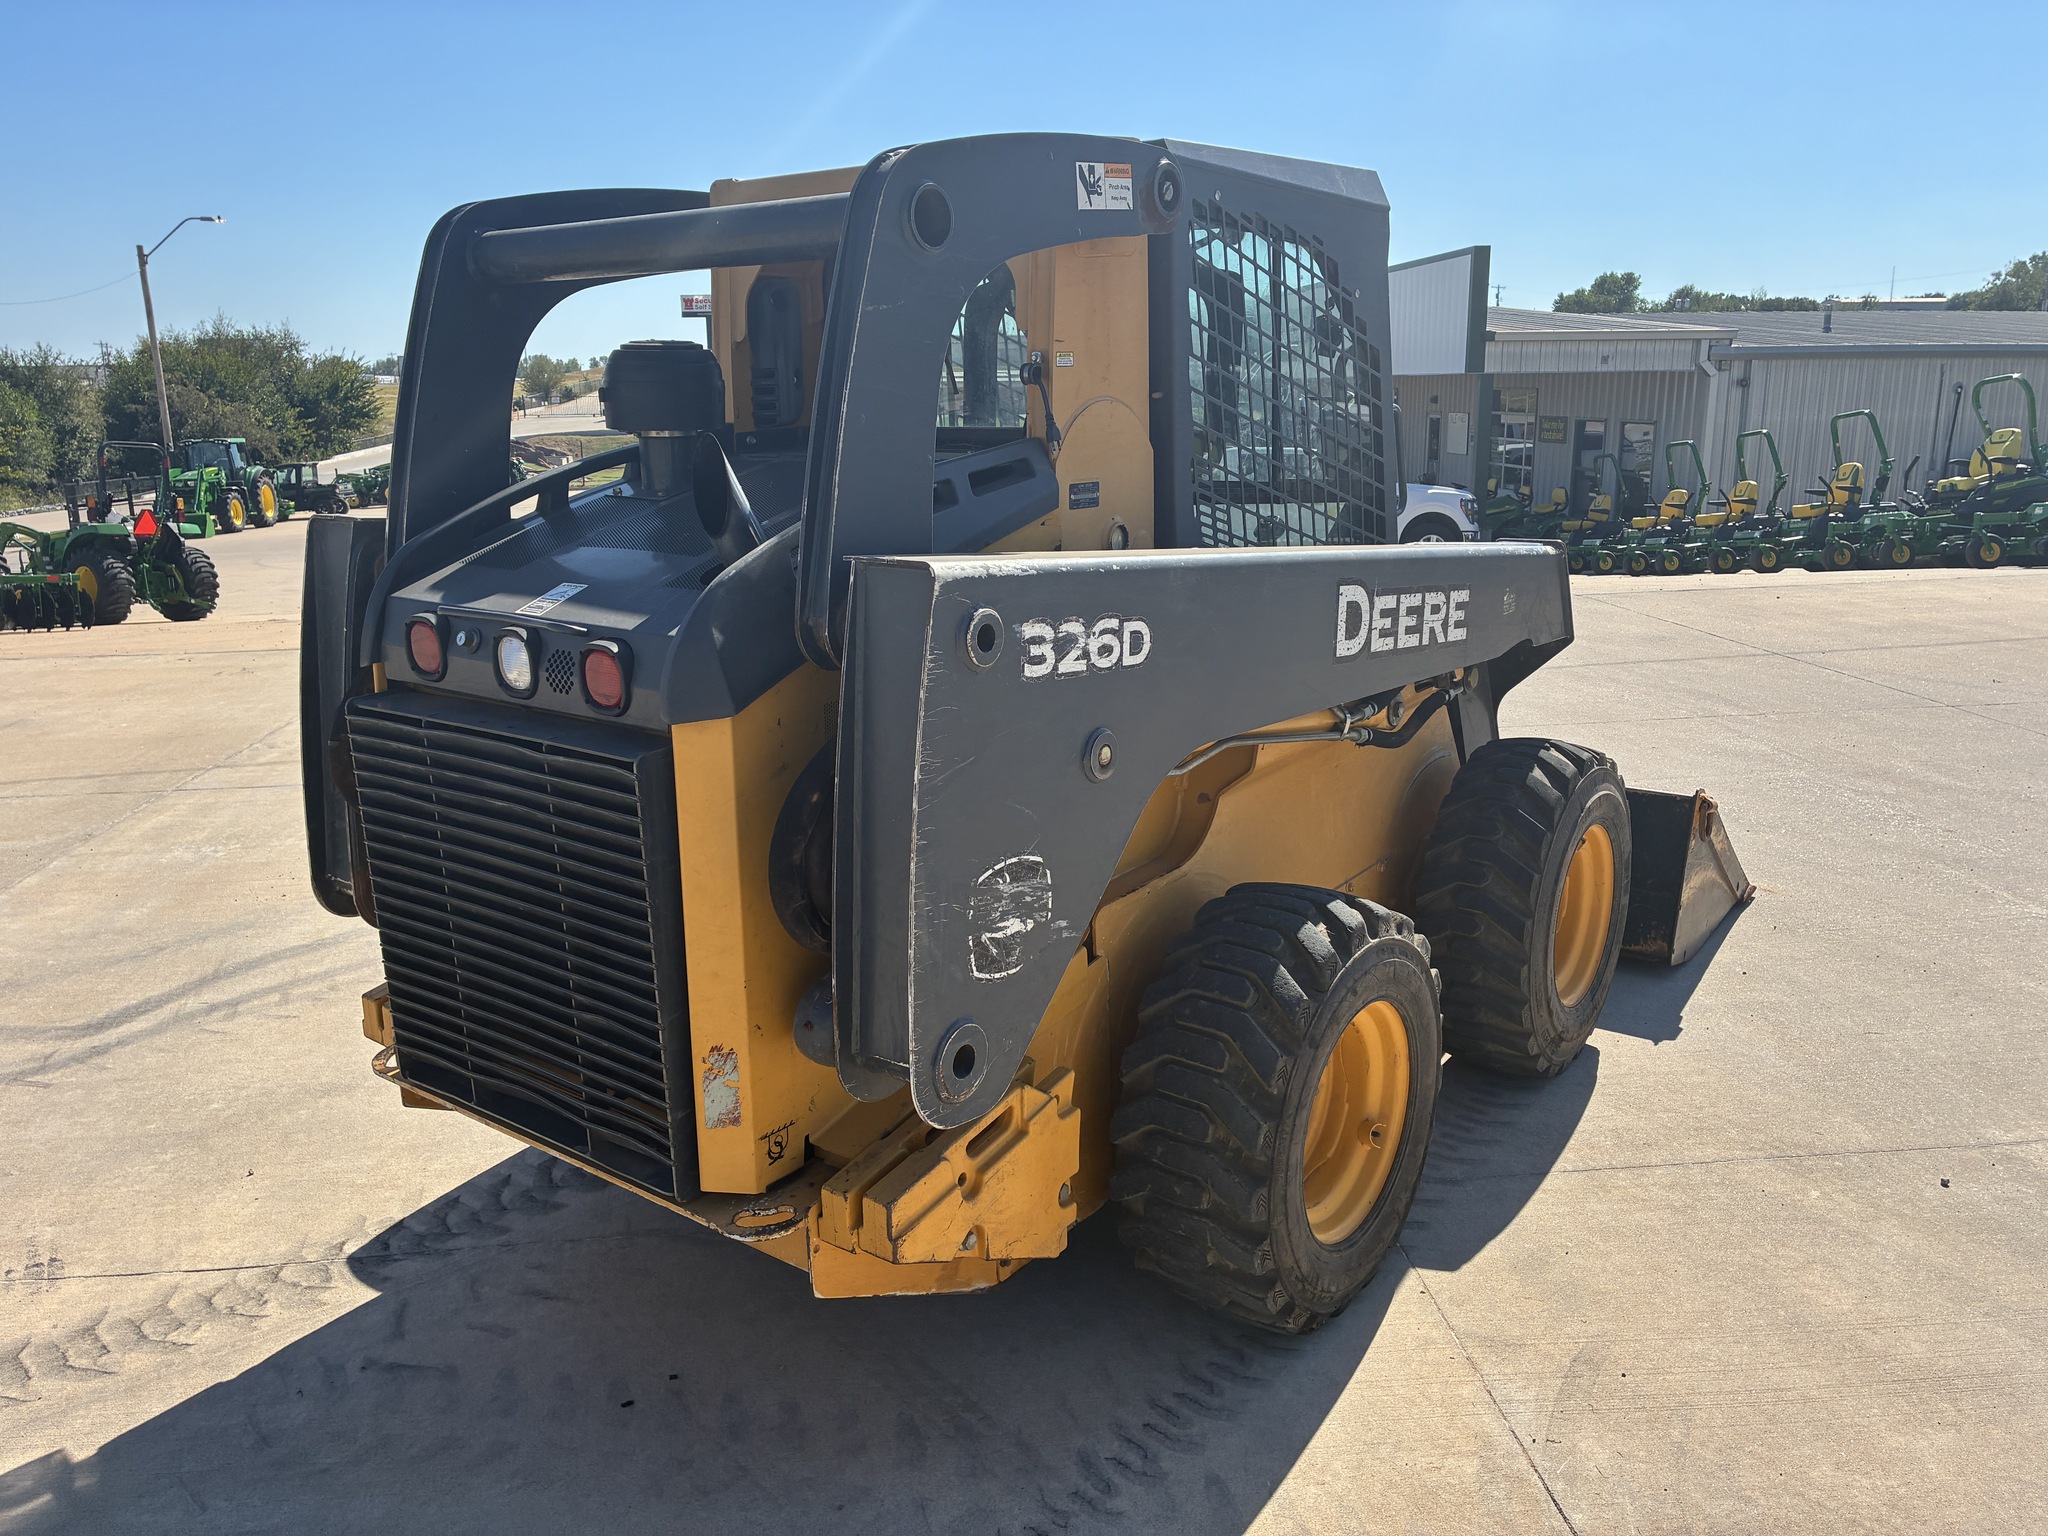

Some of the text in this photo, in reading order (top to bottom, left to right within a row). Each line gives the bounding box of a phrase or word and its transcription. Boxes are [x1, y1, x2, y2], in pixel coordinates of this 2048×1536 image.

[1109, 167, 1130, 175] WARNING
[1021, 618, 1152, 678] 326D
[1336, 584, 1470, 658] DEERE
